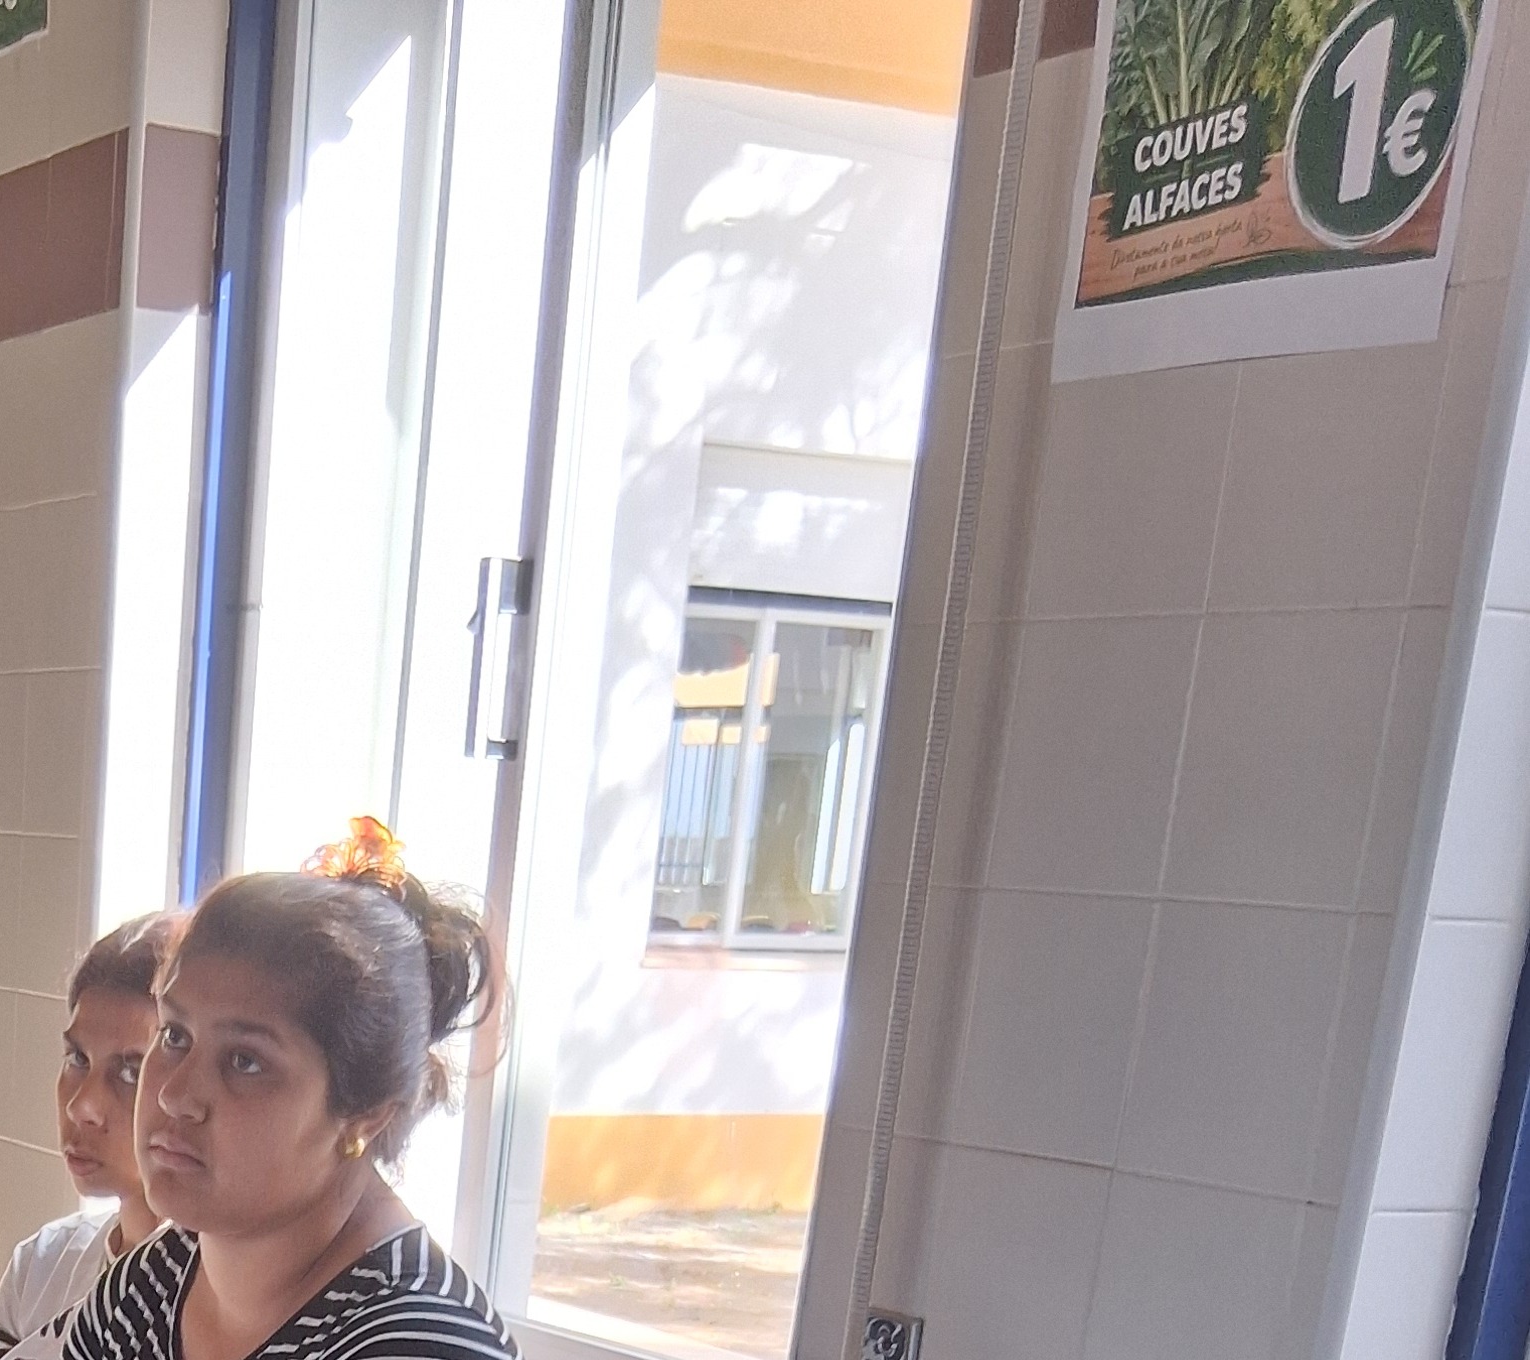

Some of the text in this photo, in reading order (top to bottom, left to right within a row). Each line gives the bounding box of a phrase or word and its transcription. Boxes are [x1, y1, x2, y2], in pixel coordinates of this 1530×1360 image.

[1134, 103, 1248, 173] COUVES
[1334, 15, 1437, 204] 1€
[1122, 162, 1244, 231] ALFACES
